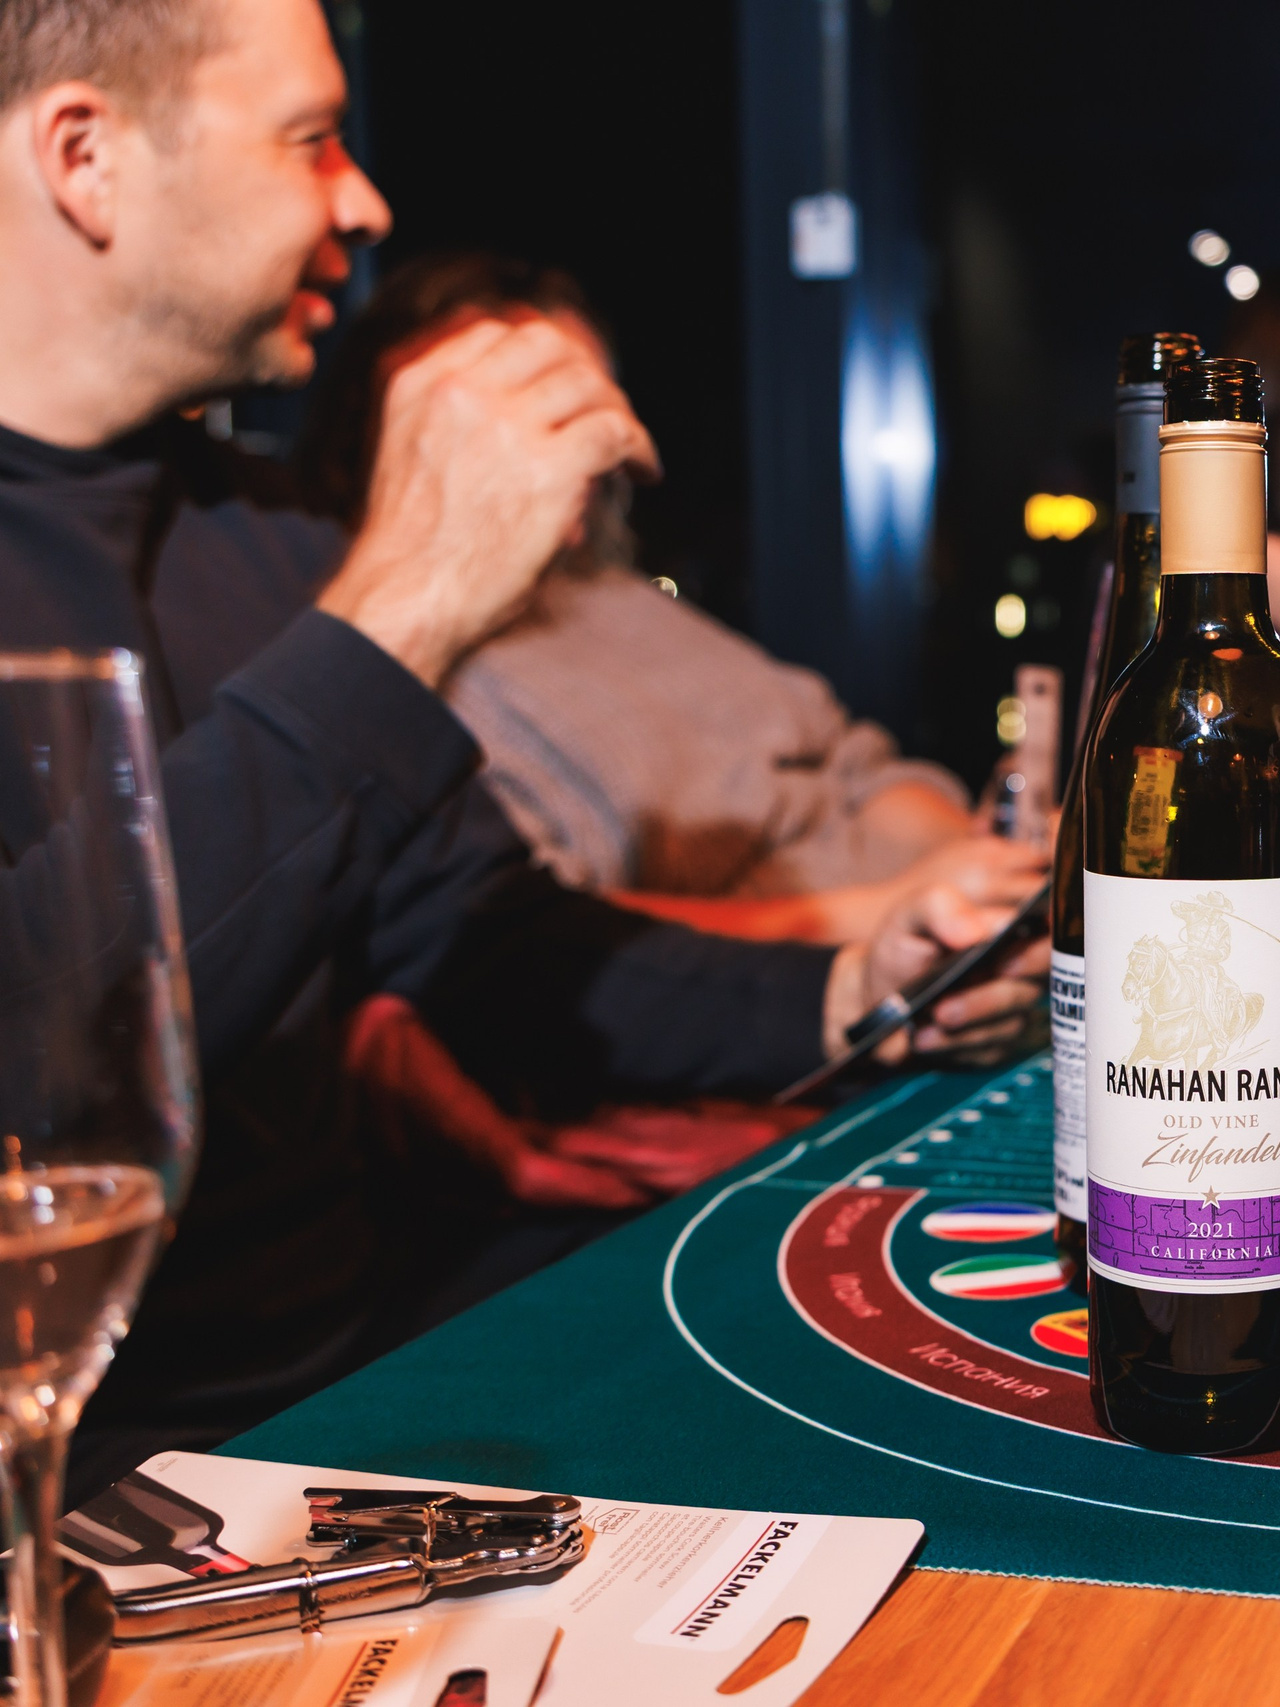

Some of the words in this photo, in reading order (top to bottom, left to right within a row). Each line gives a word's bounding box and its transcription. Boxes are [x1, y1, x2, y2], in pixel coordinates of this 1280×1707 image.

[1106, 1061, 1226, 1102] RANAHAN
[1163, 1114, 1202, 1129] OLD
[1211, 1114, 1260, 1129] VINE
[1188, 1222, 1234, 1239] 2021
[1151, 1245, 1274, 1260] CALIFORNIA
[909, 1342, 1050, 1399] Испания
[607, 1512, 631, 1530] Rost
[686, 1514, 713, 1537] Waiters
[654, 1516, 729, 1588] Kellnerkorkenzieher
[680, 1521, 799, 1638] FACKELMANN
